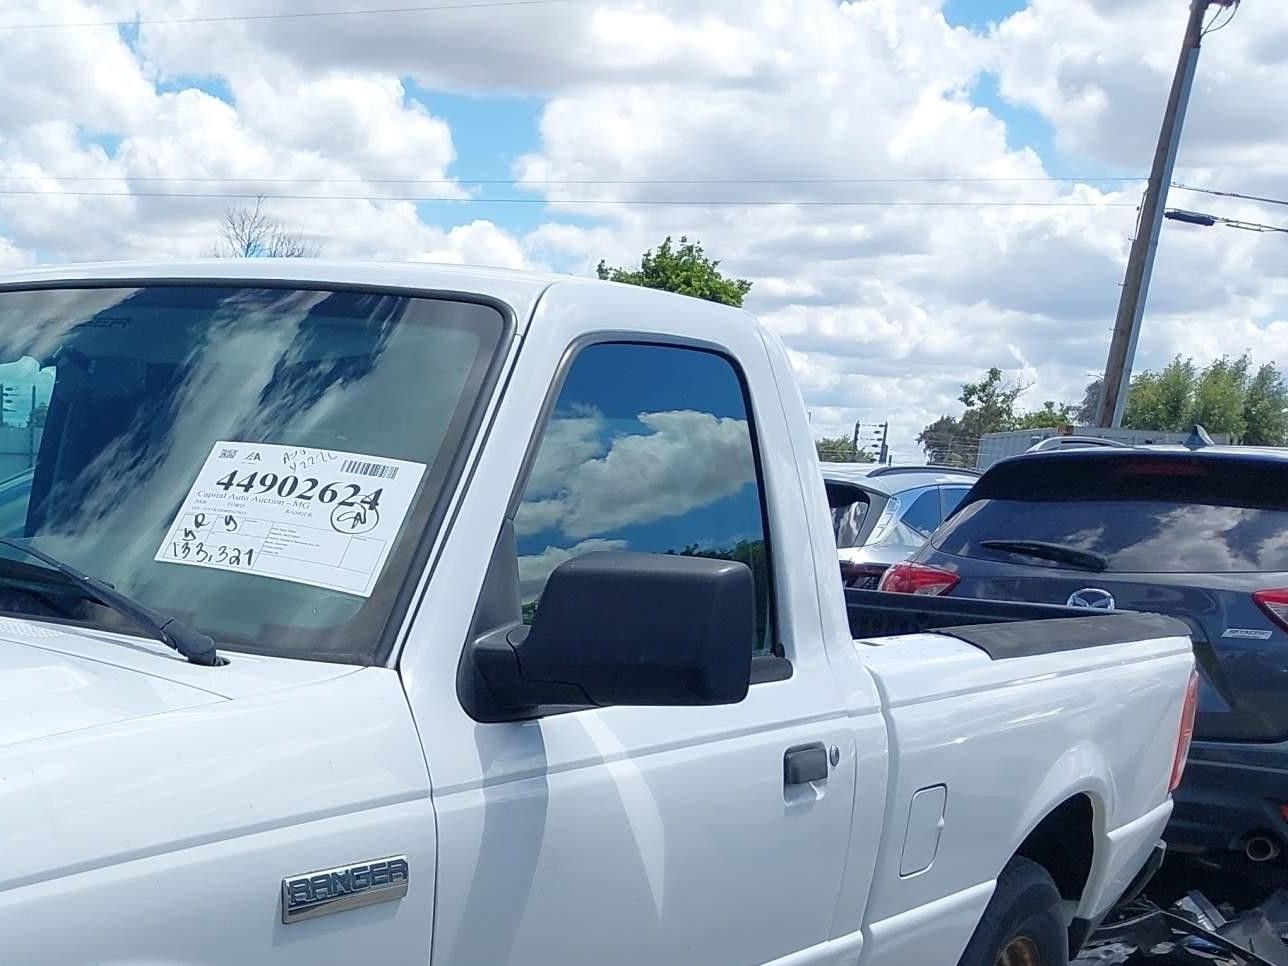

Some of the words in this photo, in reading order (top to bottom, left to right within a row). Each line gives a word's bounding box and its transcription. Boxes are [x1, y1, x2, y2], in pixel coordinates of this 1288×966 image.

[197, 490, 227, 499] Capital
[228, 493, 249, 501] Auto
[251, 496, 284, 506] Auction
[292, 500, 312, 509] MG
[215, 469, 384, 511] 44902624
[173, 541, 254, 566] 133,321
[288, 858, 409, 906] RANGER
